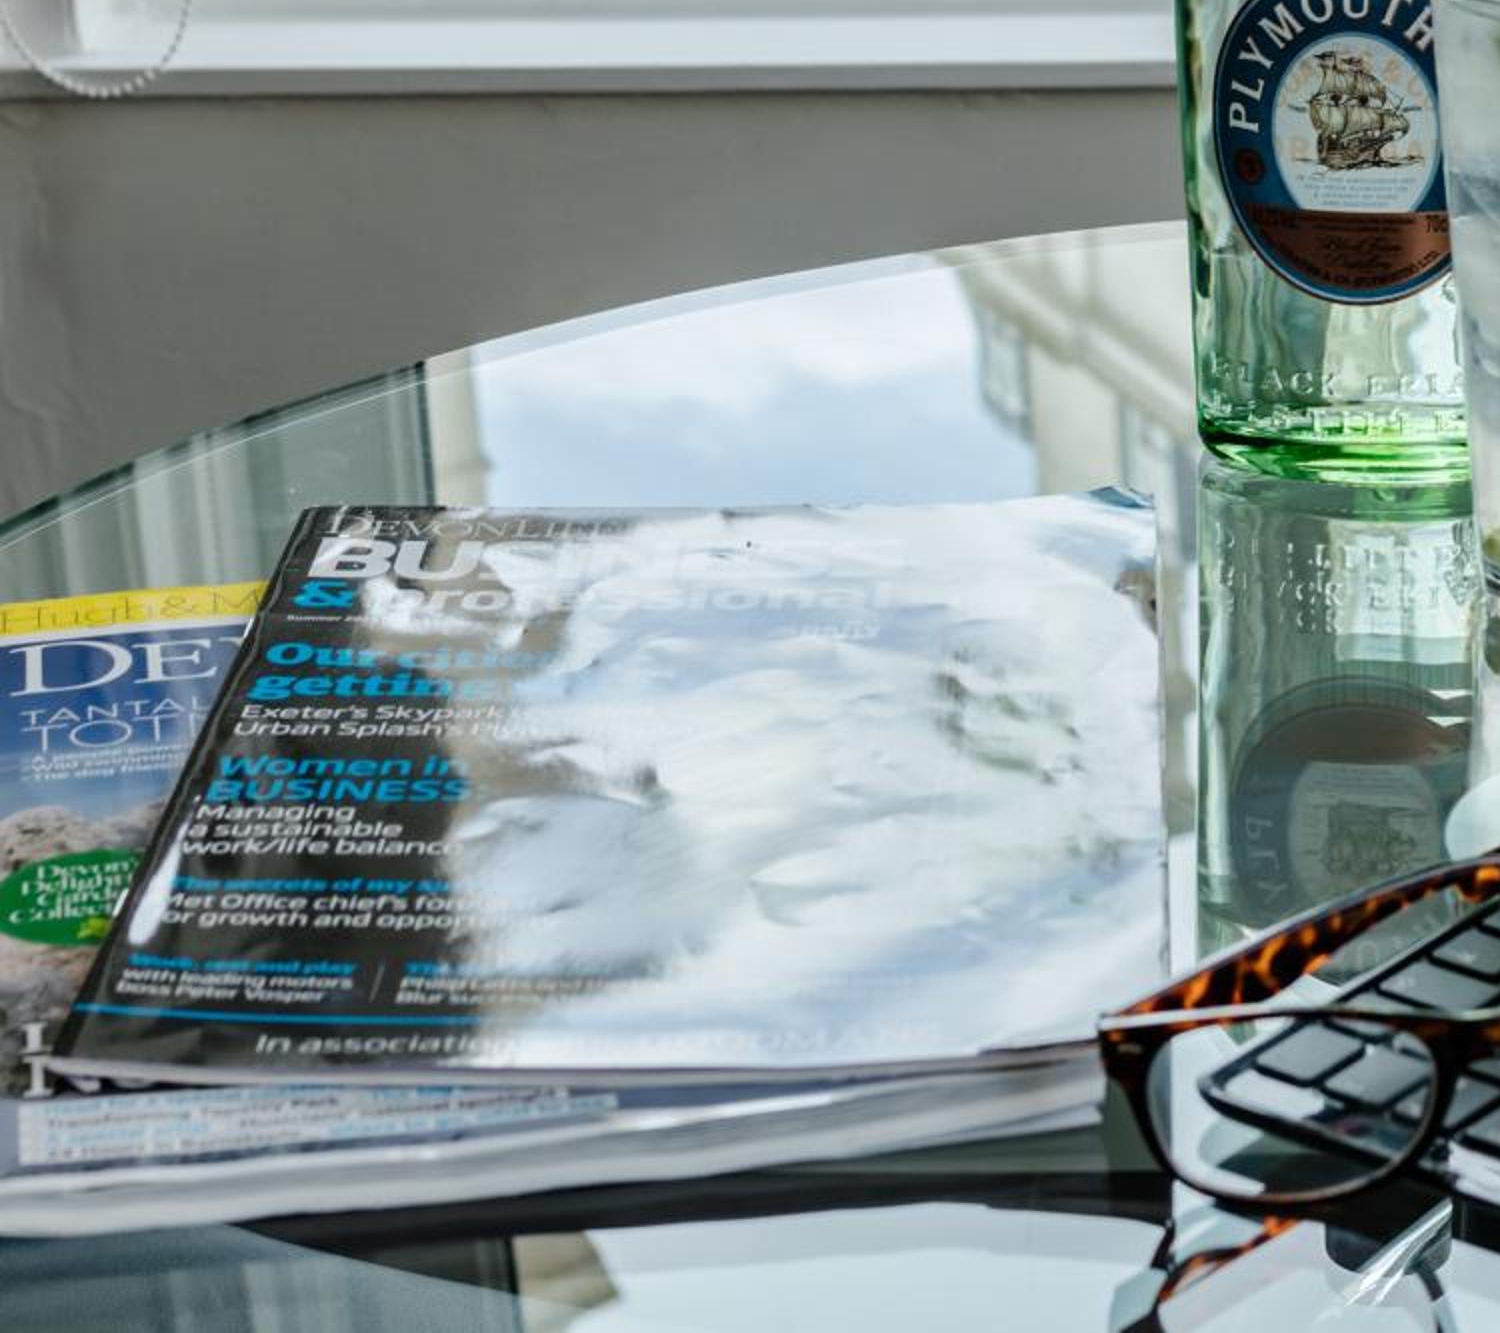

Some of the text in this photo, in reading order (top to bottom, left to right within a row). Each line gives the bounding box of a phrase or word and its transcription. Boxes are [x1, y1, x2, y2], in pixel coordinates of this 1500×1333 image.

[266, 640, 376, 668] Our
[240, 703, 503, 722] Exeter's Skypark
[233, 721, 330, 737] Urban
[217, 755, 412, 777] Women
[205, 778, 473, 803] BUSINESS
[196, 805, 356, 824] Managing
[187, 821, 402, 838] a sustainable
[182, 838, 328, 855] work/life
[221, 892, 307, 910] Office
[313, 894, 408, 912] chief's
[196, 906, 307, 925] growth
[314, 908, 371, 924] and
[269, 975, 354, 990] motors
[256, 1033, 291, 1055] In
